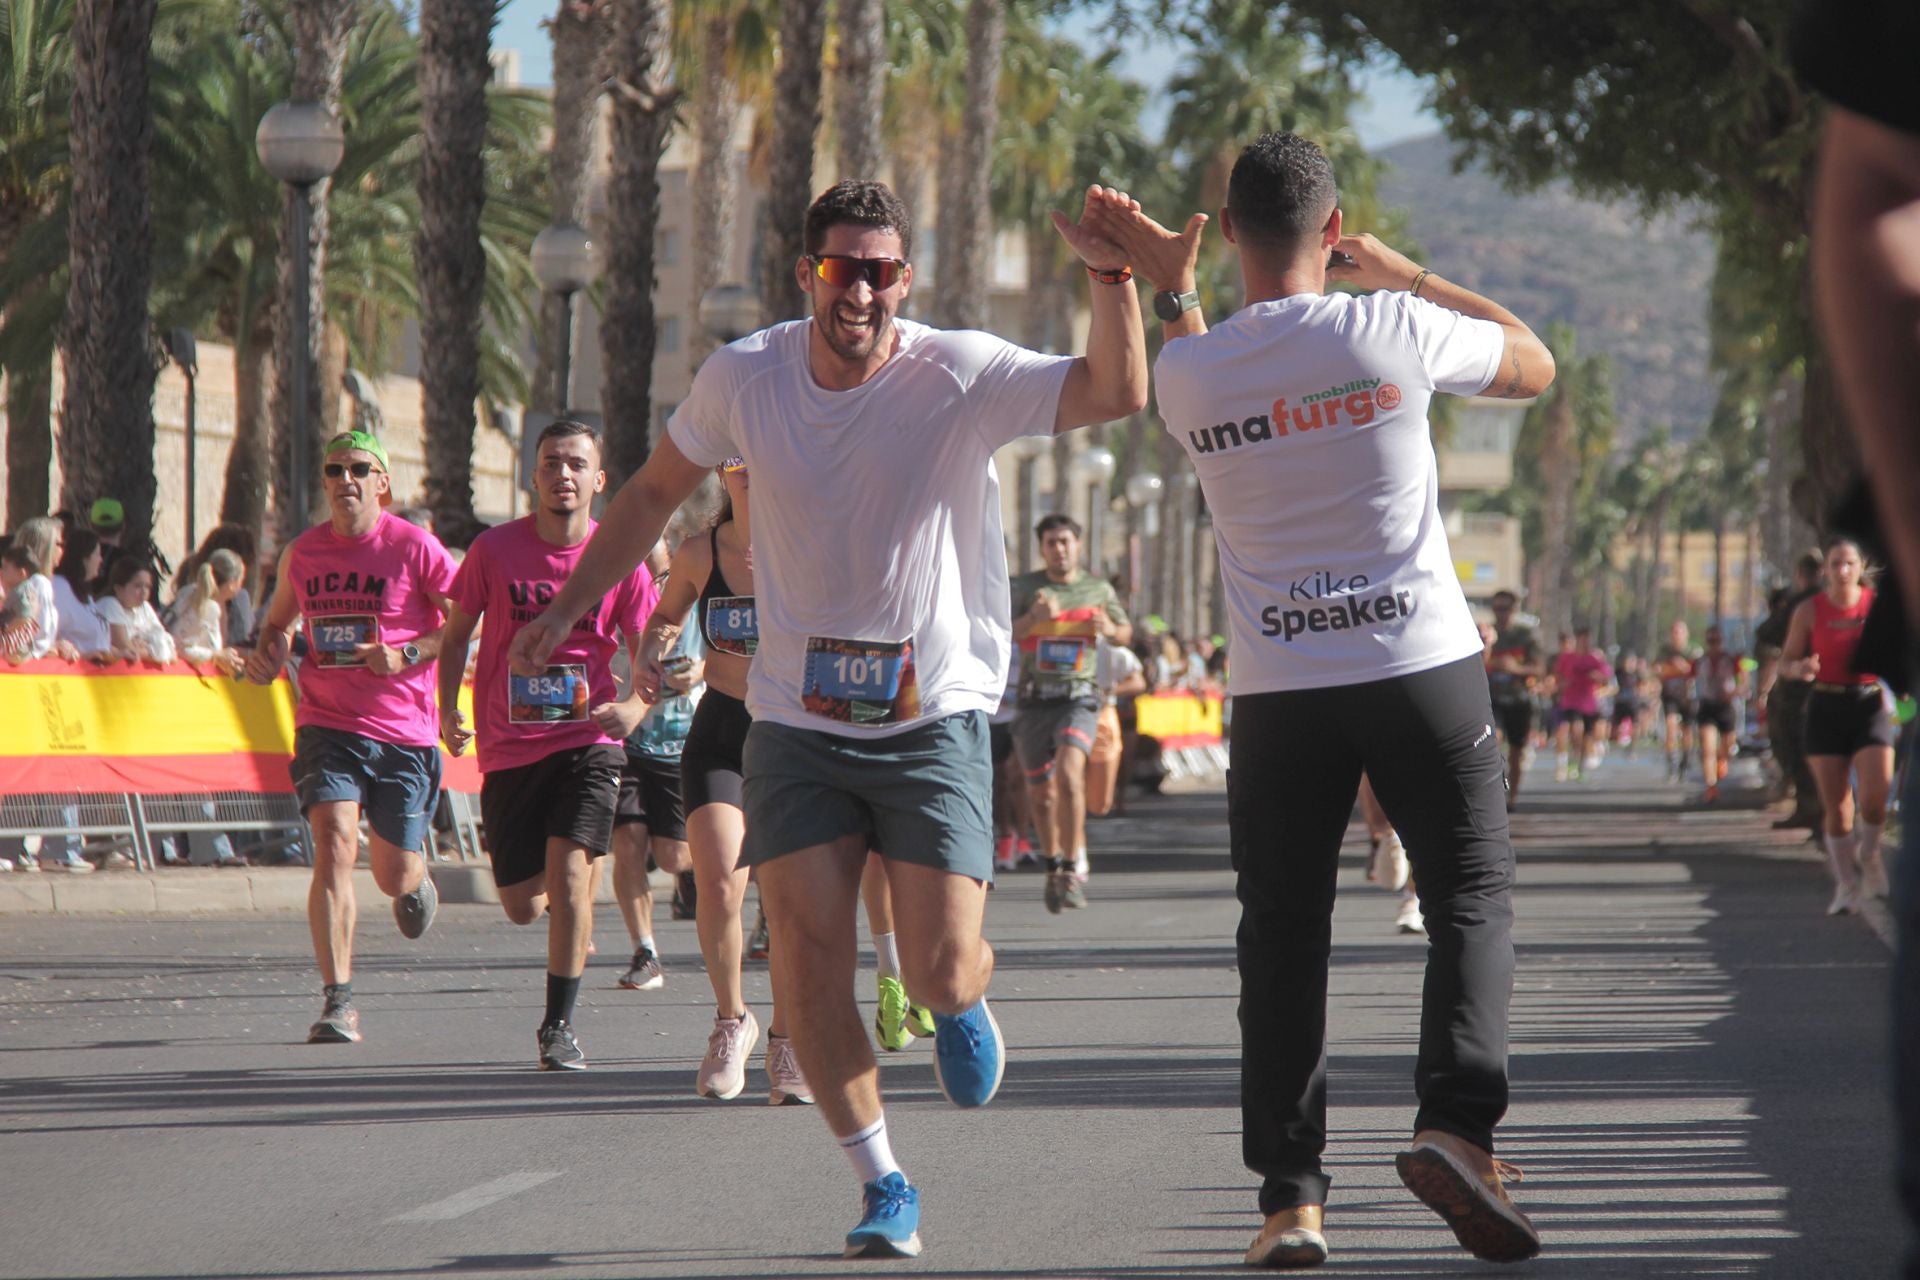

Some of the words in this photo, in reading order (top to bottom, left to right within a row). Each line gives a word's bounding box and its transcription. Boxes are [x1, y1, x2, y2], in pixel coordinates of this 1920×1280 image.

[1302, 377, 1381, 404] mobility
[305, 572, 387, 597] UCAM
[1289, 571, 1369, 602] Kike
[304, 598, 383, 612] UNIVERSIDAD
[1260, 589, 1410, 642] Speaker
[727, 609, 759, 629] 81
[321, 626, 356, 644] 725
[833, 656, 882, 686] 101
[527, 677, 565, 695] 834
